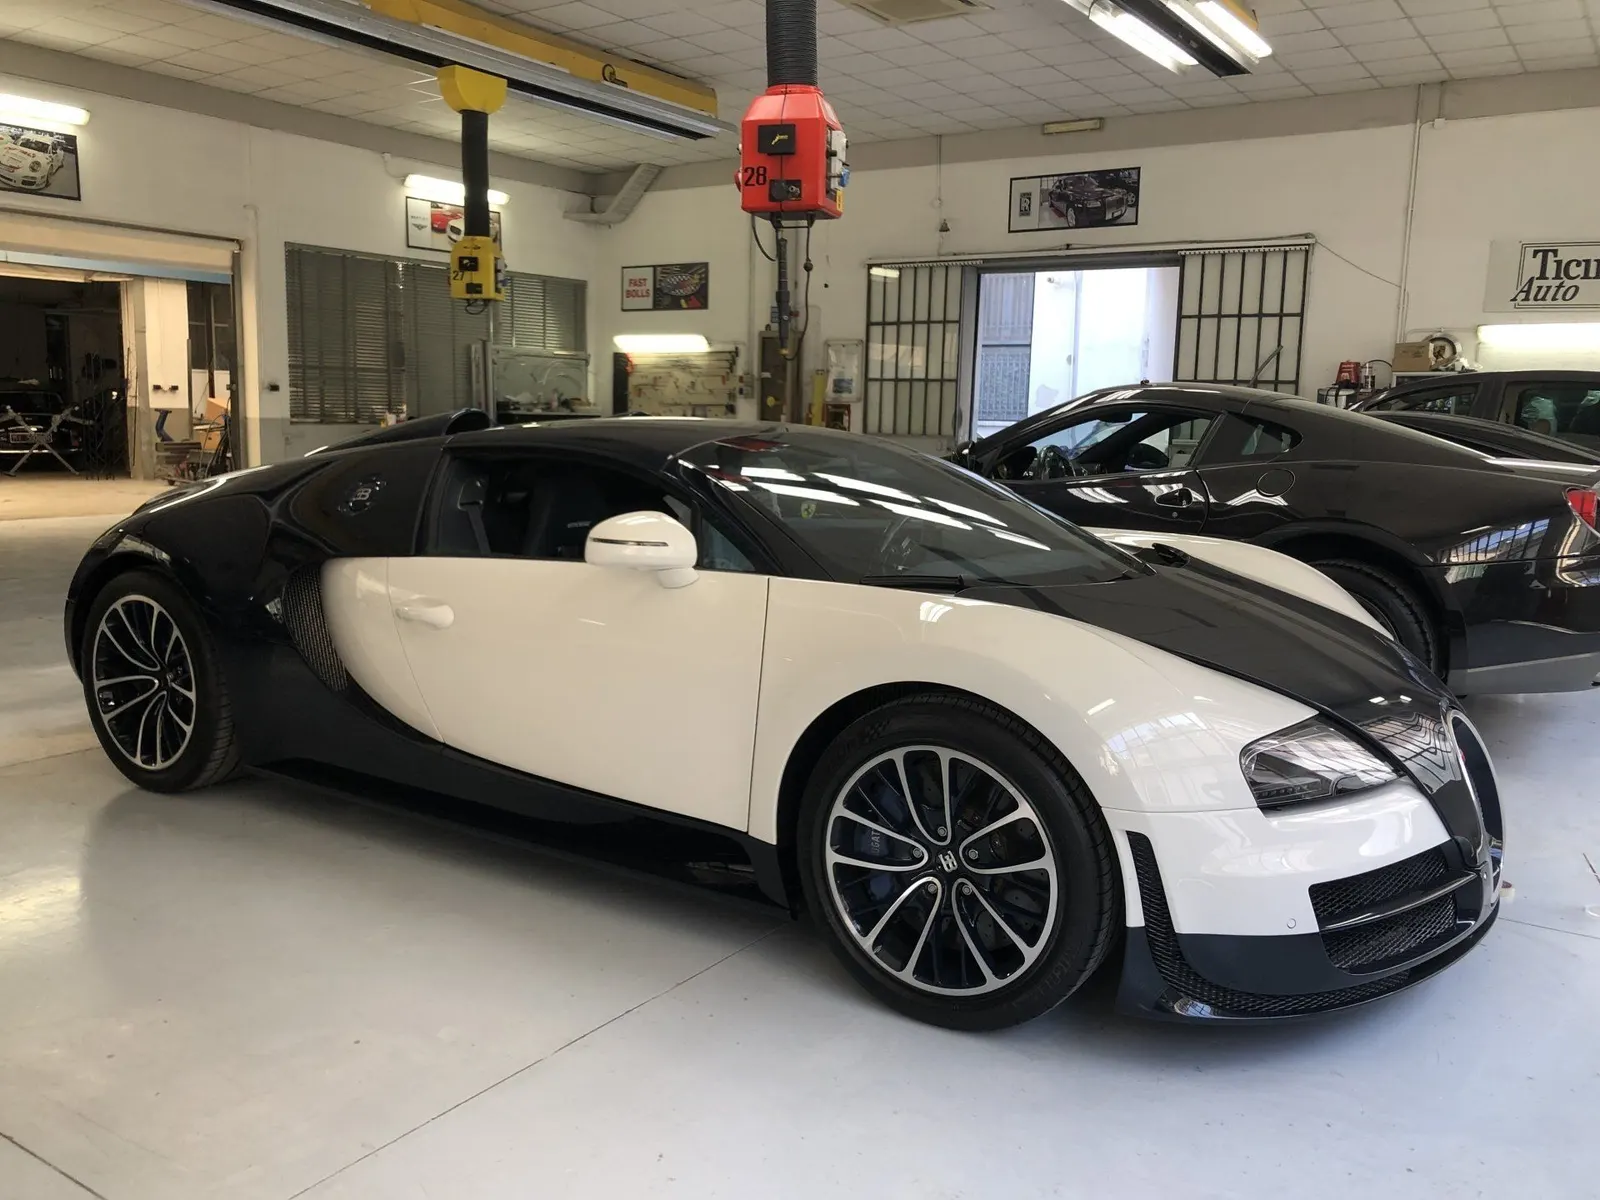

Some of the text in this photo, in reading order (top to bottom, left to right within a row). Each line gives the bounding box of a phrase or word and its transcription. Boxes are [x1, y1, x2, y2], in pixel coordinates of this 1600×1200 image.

[744, 166, 767, 187] 28
[452, 270, 464, 281] 27
[628, 278, 647, 287] FAST
[1509, 276, 1580, 302] Auto
